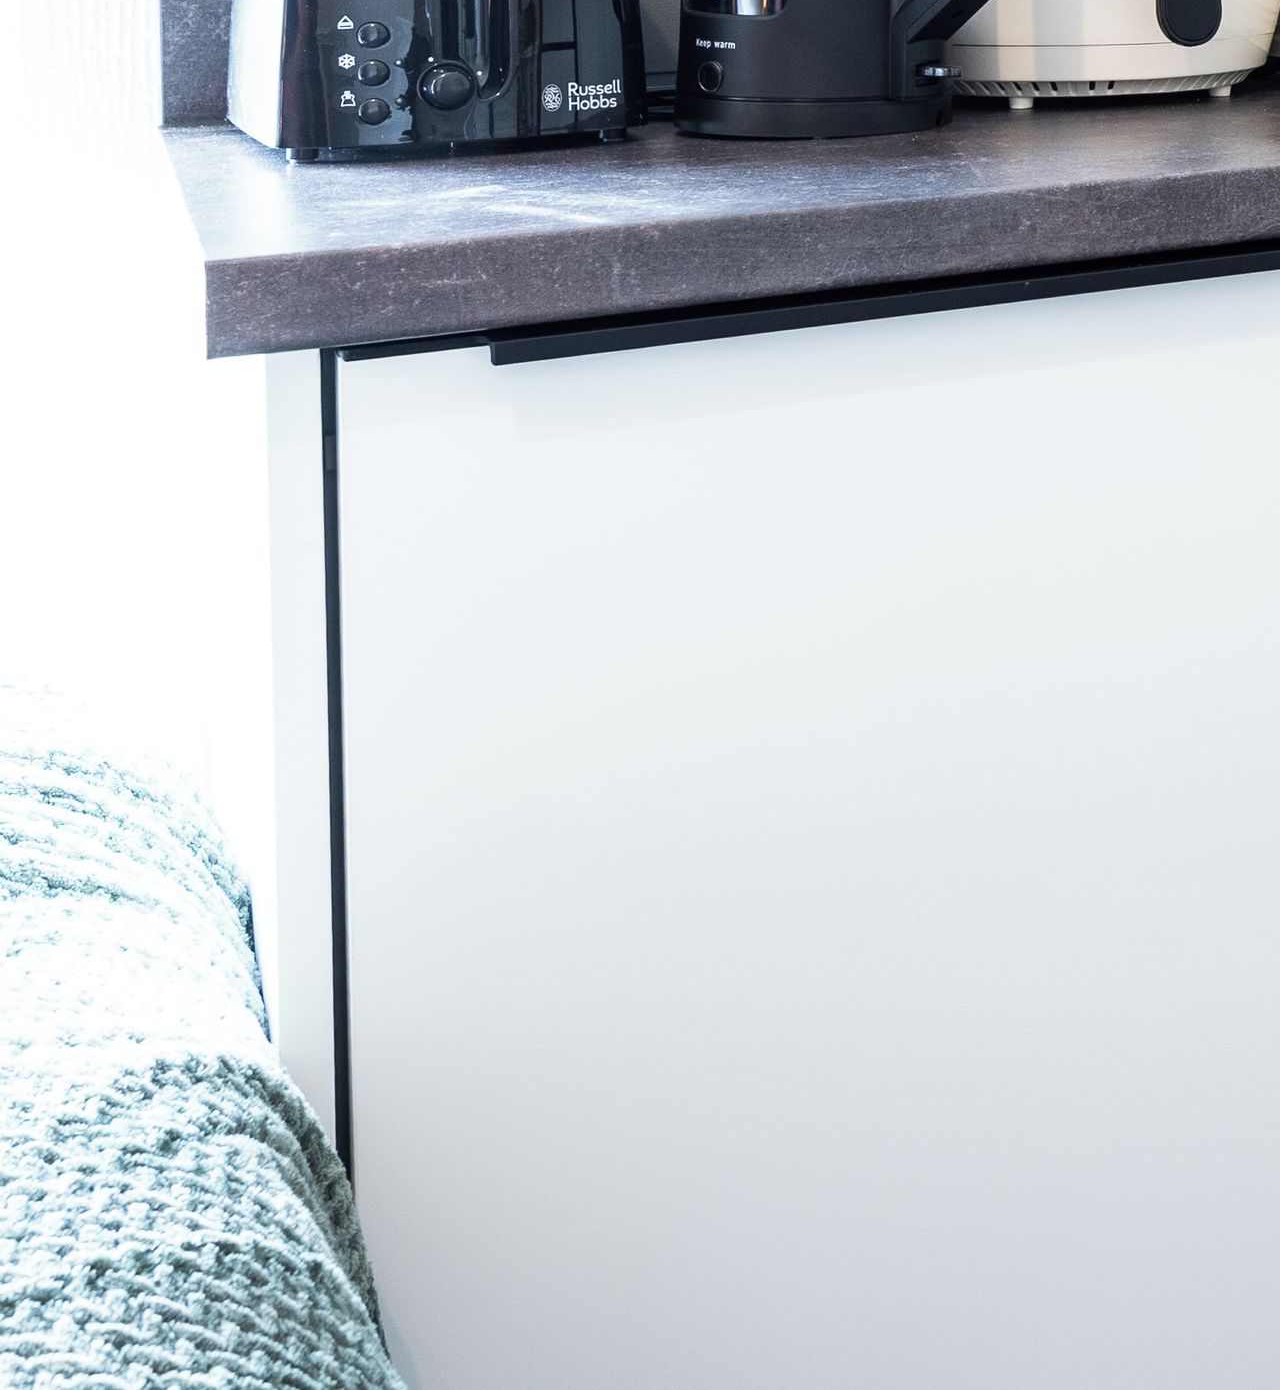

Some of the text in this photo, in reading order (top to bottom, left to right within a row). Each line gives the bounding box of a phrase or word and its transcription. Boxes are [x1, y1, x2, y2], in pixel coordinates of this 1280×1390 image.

[695, 38, 736, 50] Keep warm
[567, 79, 621, 97] Russell
[568, 95, 618, 111] Hobbs
